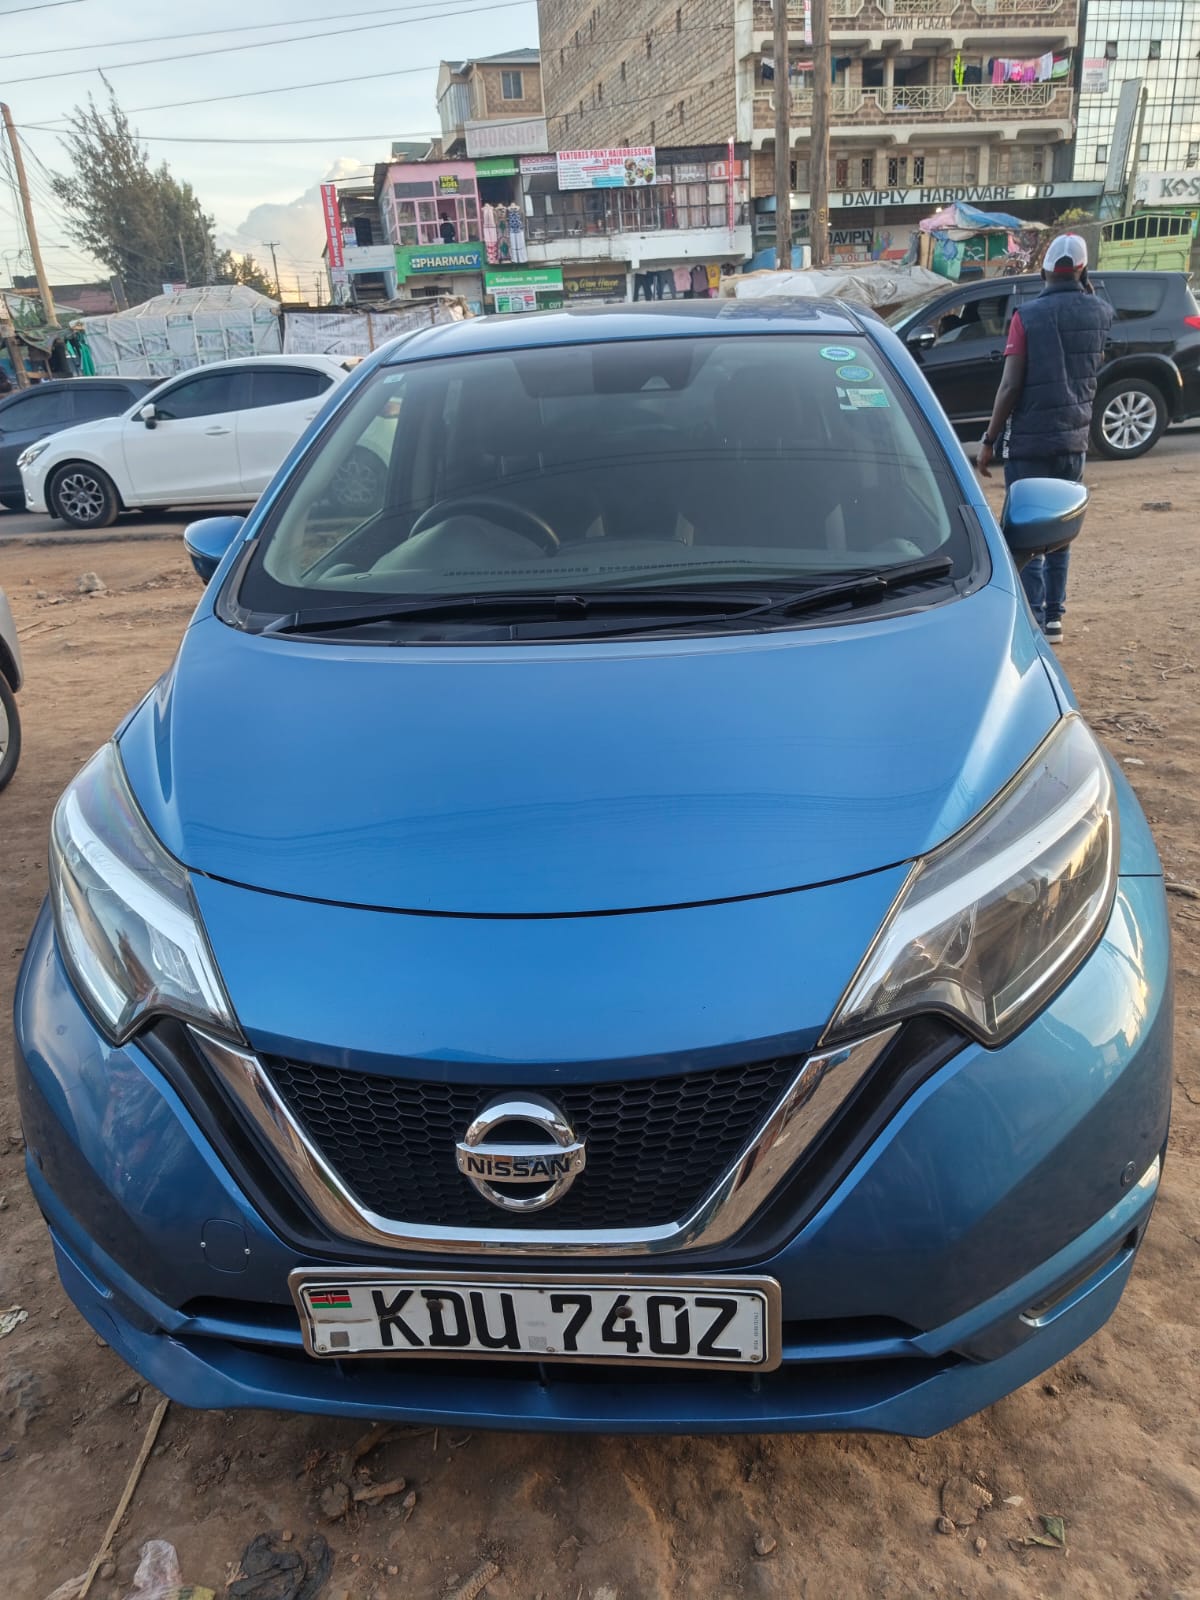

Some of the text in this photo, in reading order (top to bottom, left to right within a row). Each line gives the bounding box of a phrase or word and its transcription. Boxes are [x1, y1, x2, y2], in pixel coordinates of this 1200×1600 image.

[917, 16, 948, 30] PLAZA
[470, 125, 544, 148] BOOKSHOP
[559, 148, 652, 160] VENTURES POINT HAIRDRESSING
[602, 158, 624, 166] SCHOOL
[842, 184, 1055, 207] DAVIPLY HARDWARE LTD
[324, 186, 342, 266] VENTURES
[421, 255, 479, 268] PHARMACY
[467, 1156, 571, 1178] NISSAN
[372, 1289, 521, 1350] KDU
[550, 1294, 742, 1359] 740Z
